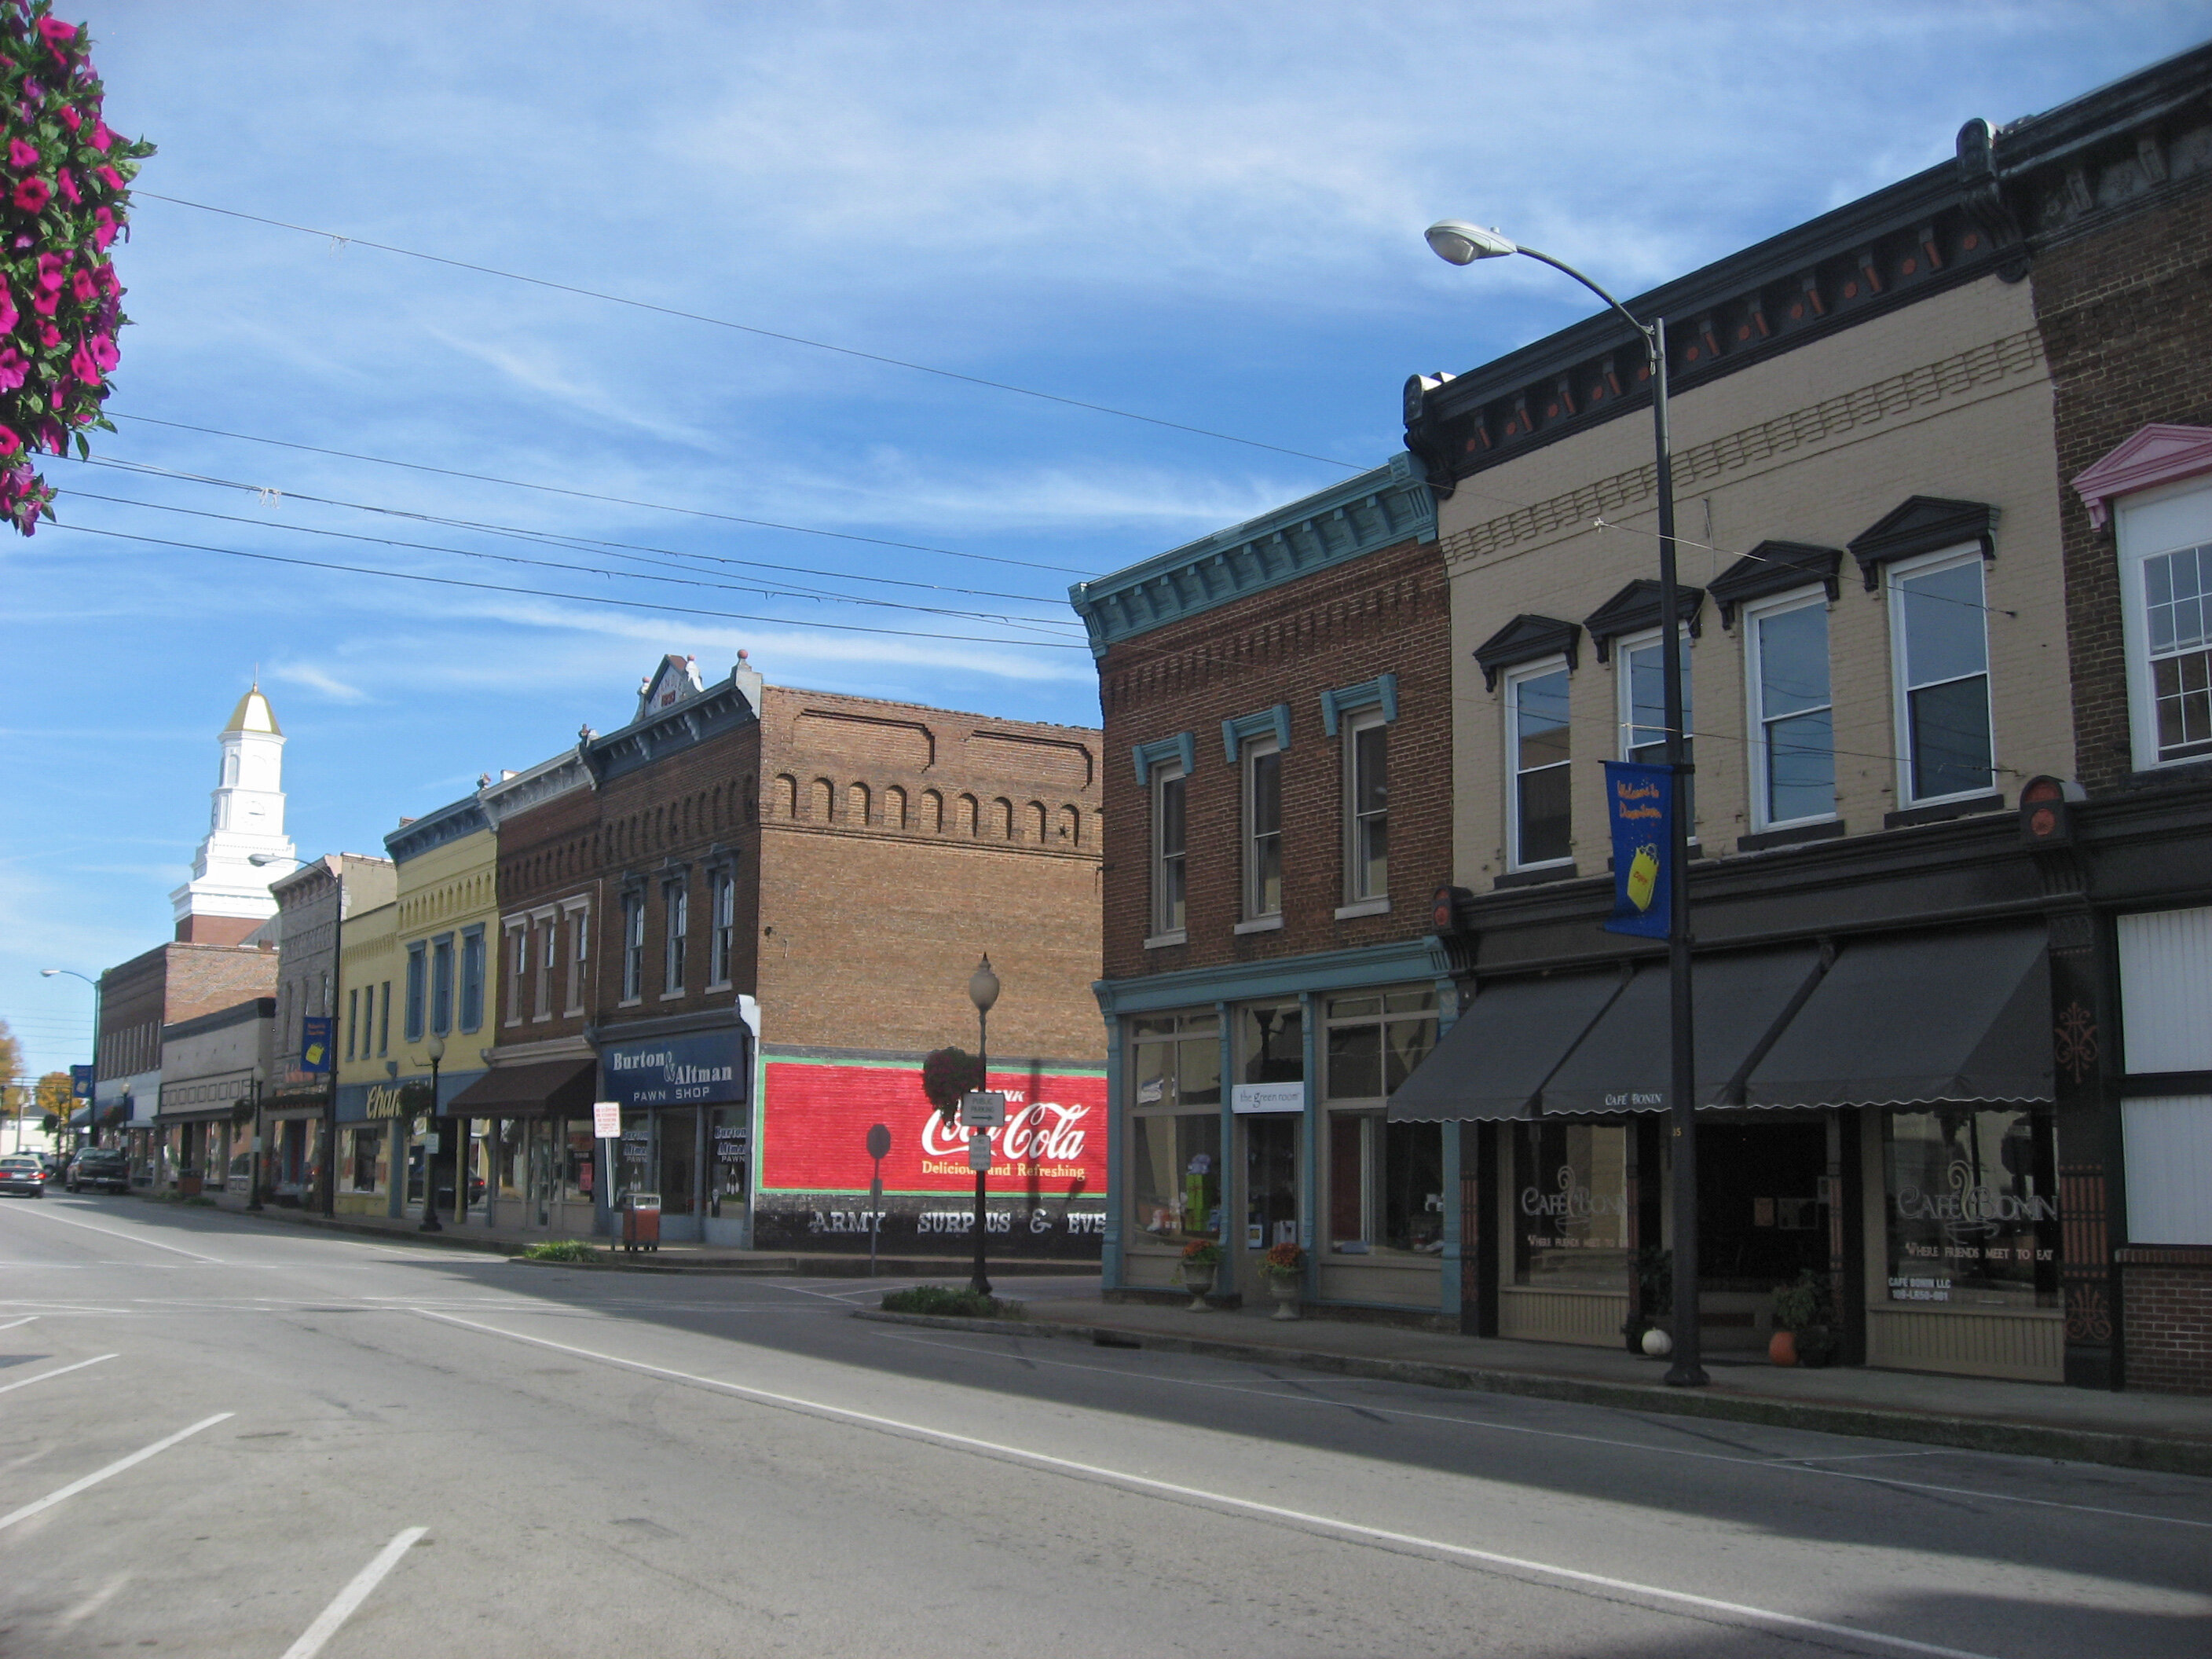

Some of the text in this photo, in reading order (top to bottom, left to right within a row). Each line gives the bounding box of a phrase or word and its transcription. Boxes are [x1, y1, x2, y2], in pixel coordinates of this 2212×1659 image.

[613, 1050, 733, 1086] Burton & Altman
[633, 1086, 710, 1102] PAWN SHOP
[1240, 1090, 1252, 1102] the
[1252, 1090, 1277, 1108] green
[921, 1160, 1086, 1181] Deliciou and Refreshing
[810, 1211, 887, 1234] ARMY
[917, 1211, 1011, 1234] SURPUS
[1029, 1208, 1053, 1234] &
[1944, 1247, 1980, 1258] FRIENDS
[1985, 1247, 2010, 1259] MEET
[2015, 1248, 2031, 1260] TO
[2036, 1249, 2053, 1261] EAT
[1936, 1279, 1952, 1289] LLC
